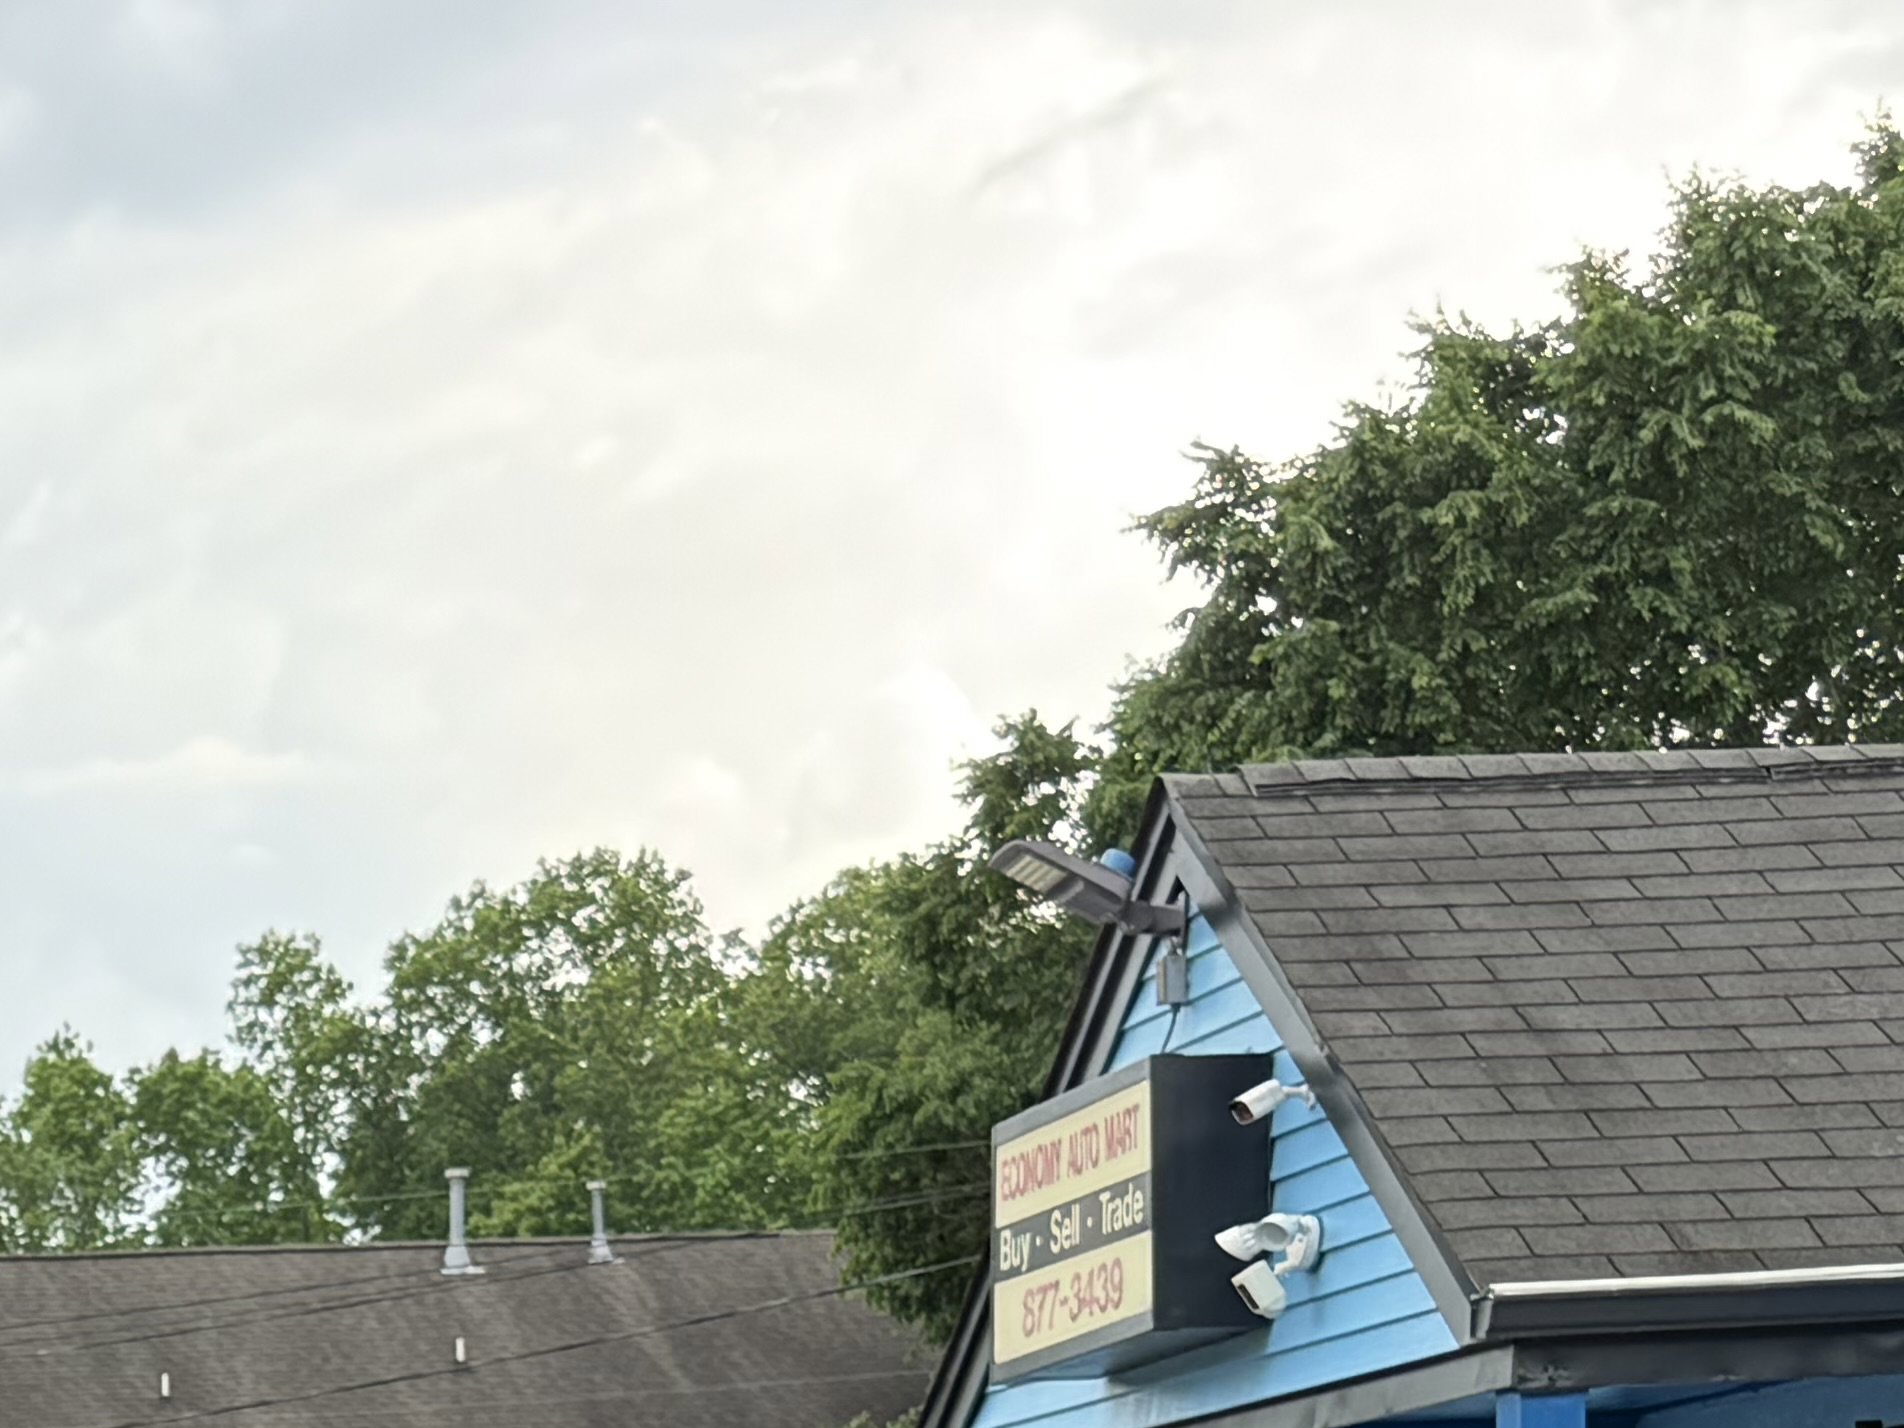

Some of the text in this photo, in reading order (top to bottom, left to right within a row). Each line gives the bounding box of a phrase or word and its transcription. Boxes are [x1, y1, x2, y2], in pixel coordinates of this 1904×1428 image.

[1002, 1102, 1141, 1202] ECONOMY AUTO MART
[999, 1184, 1144, 1272] Buy Sell Trade
[1022, 1259, 1124, 1338] 877-3439
